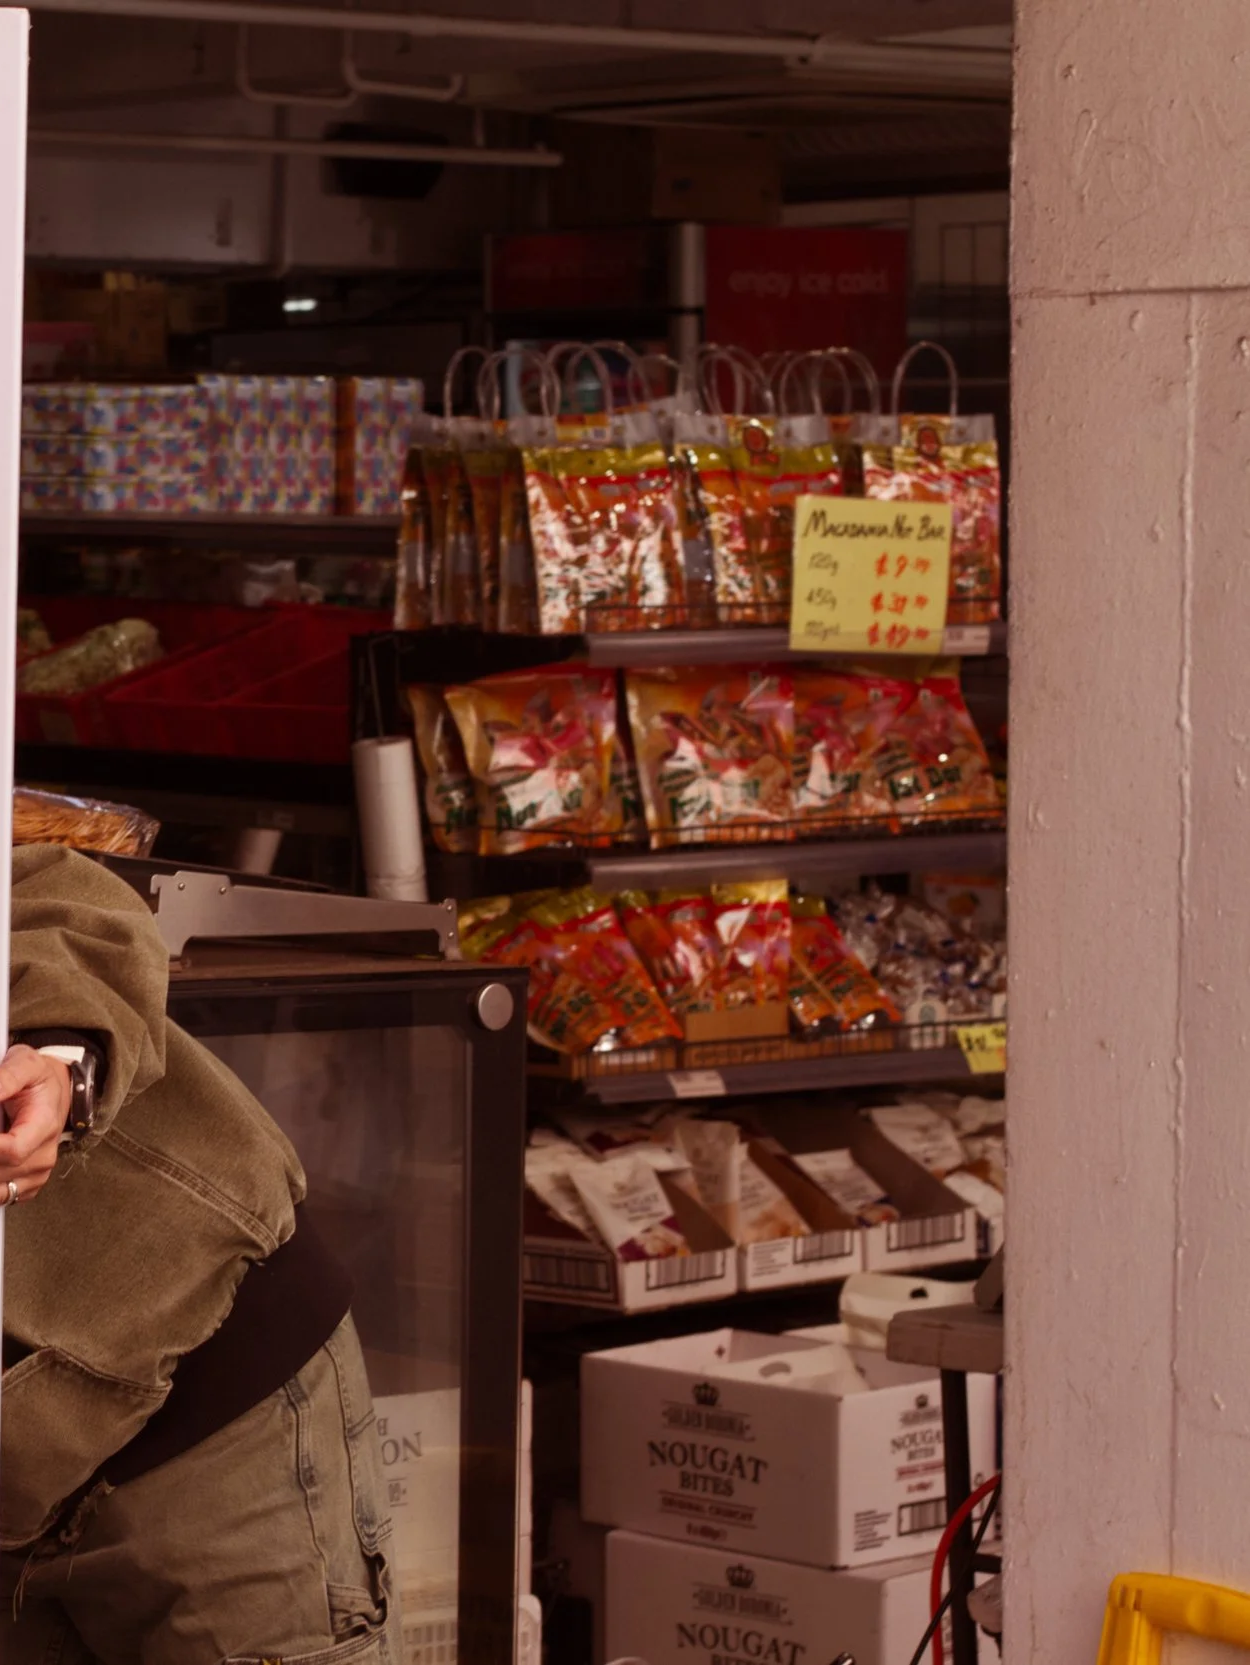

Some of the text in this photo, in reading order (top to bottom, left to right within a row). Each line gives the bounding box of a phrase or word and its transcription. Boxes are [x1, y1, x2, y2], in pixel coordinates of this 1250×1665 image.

[727, 267, 889, 297] enjoy ice cold
[647, 1439, 770, 1485] NOUGAT
[679, 1470, 734, 1497] BITES
[675, 1621, 808, 1665] NOUGAT
